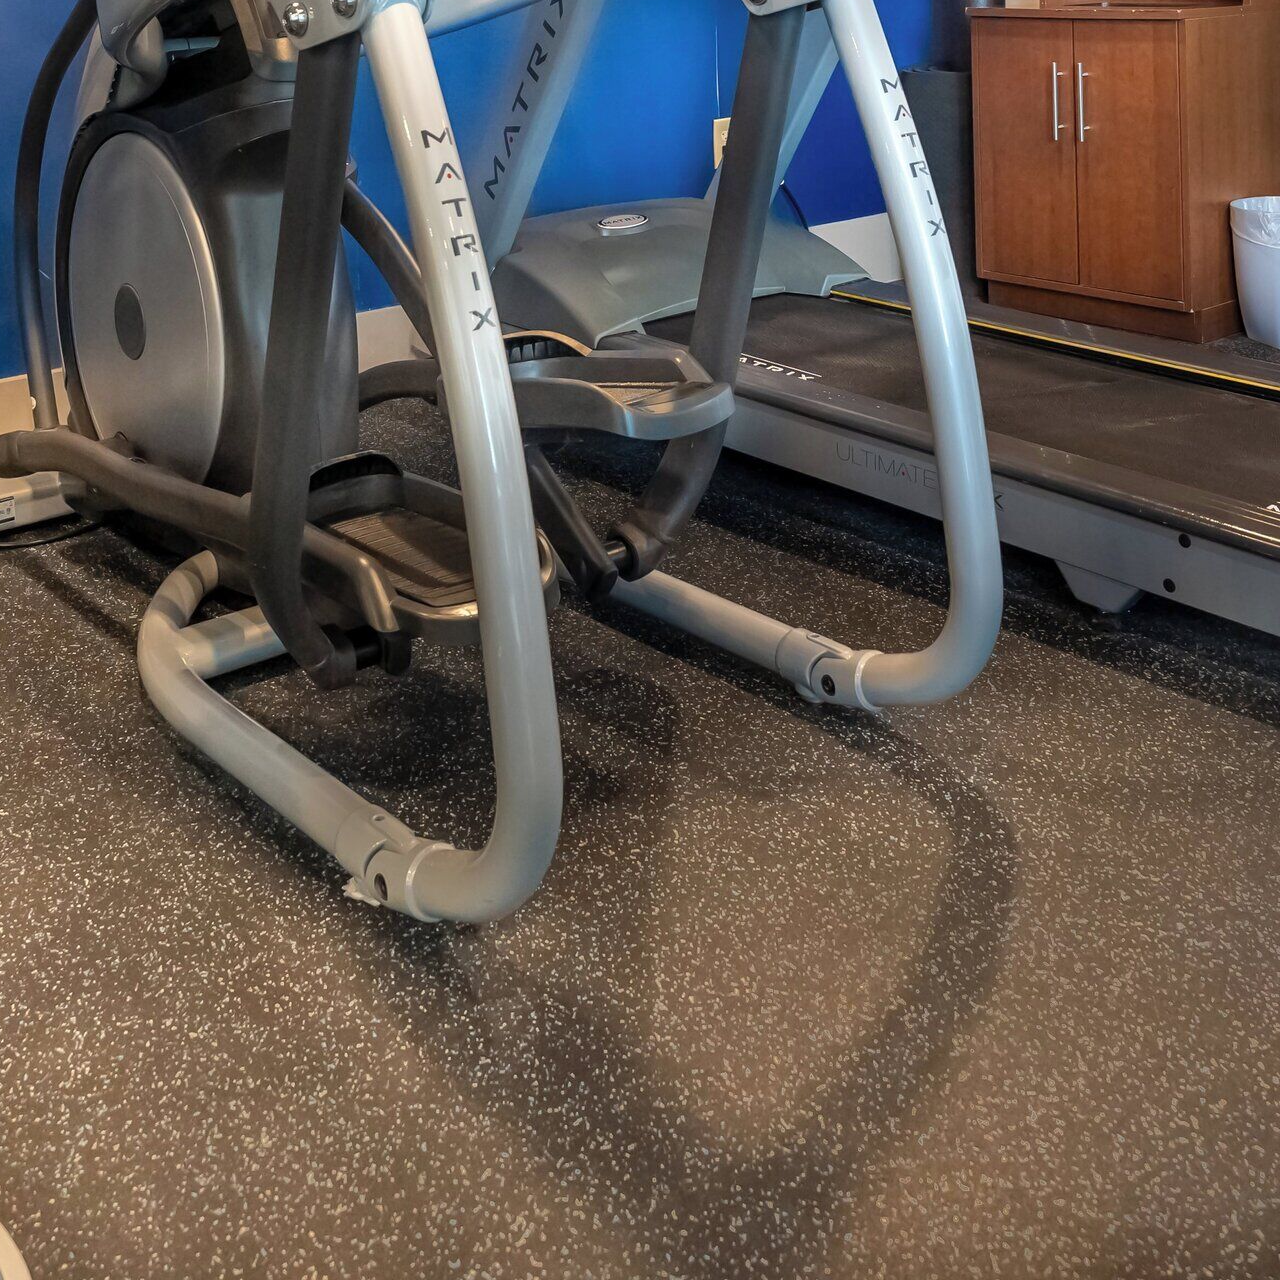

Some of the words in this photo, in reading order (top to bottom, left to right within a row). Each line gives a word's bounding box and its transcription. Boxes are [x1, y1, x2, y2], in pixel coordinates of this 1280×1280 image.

[880, 75, 947, 237] MATRIX
[420, 126, 497, 332] MATRIX
[602, 215, 642, 225] MATRIX
[739, 356, 815, 381] ATRIX
[835, 440, 937, 491] ULTIMATE
